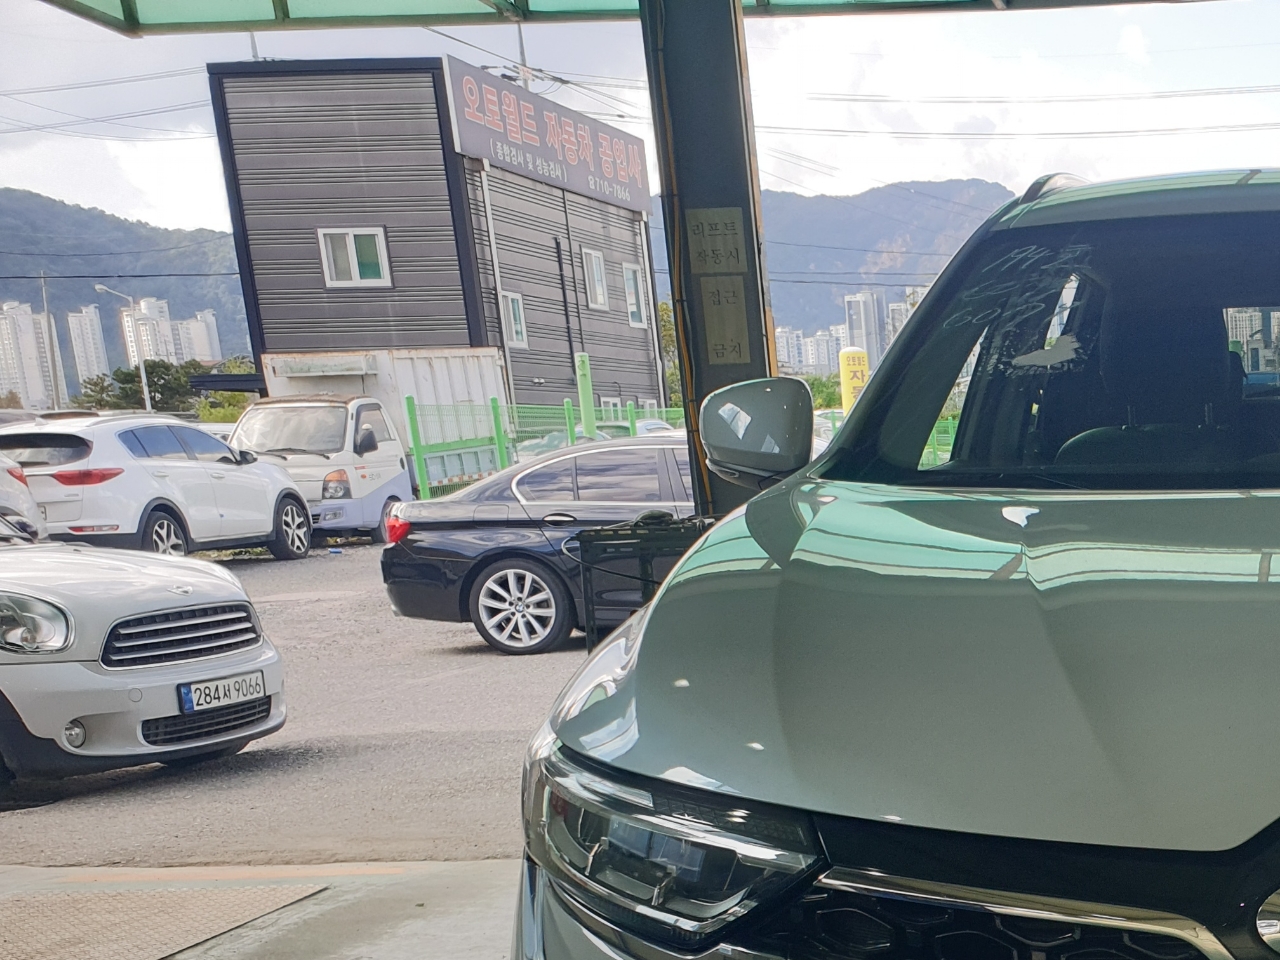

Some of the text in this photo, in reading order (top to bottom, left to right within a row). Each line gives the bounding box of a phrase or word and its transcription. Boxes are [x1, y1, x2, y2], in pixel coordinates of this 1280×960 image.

[462, 76, 642, 188] 오토월드 자동차 공업사
[526, 152, 534, 171] 및
[691, 221, 738, 238] 리프트
[696, 247, 740, 265] 작동시
[708, 289, 738, 306] 접근
[713, 340, 742, 359] 금지
